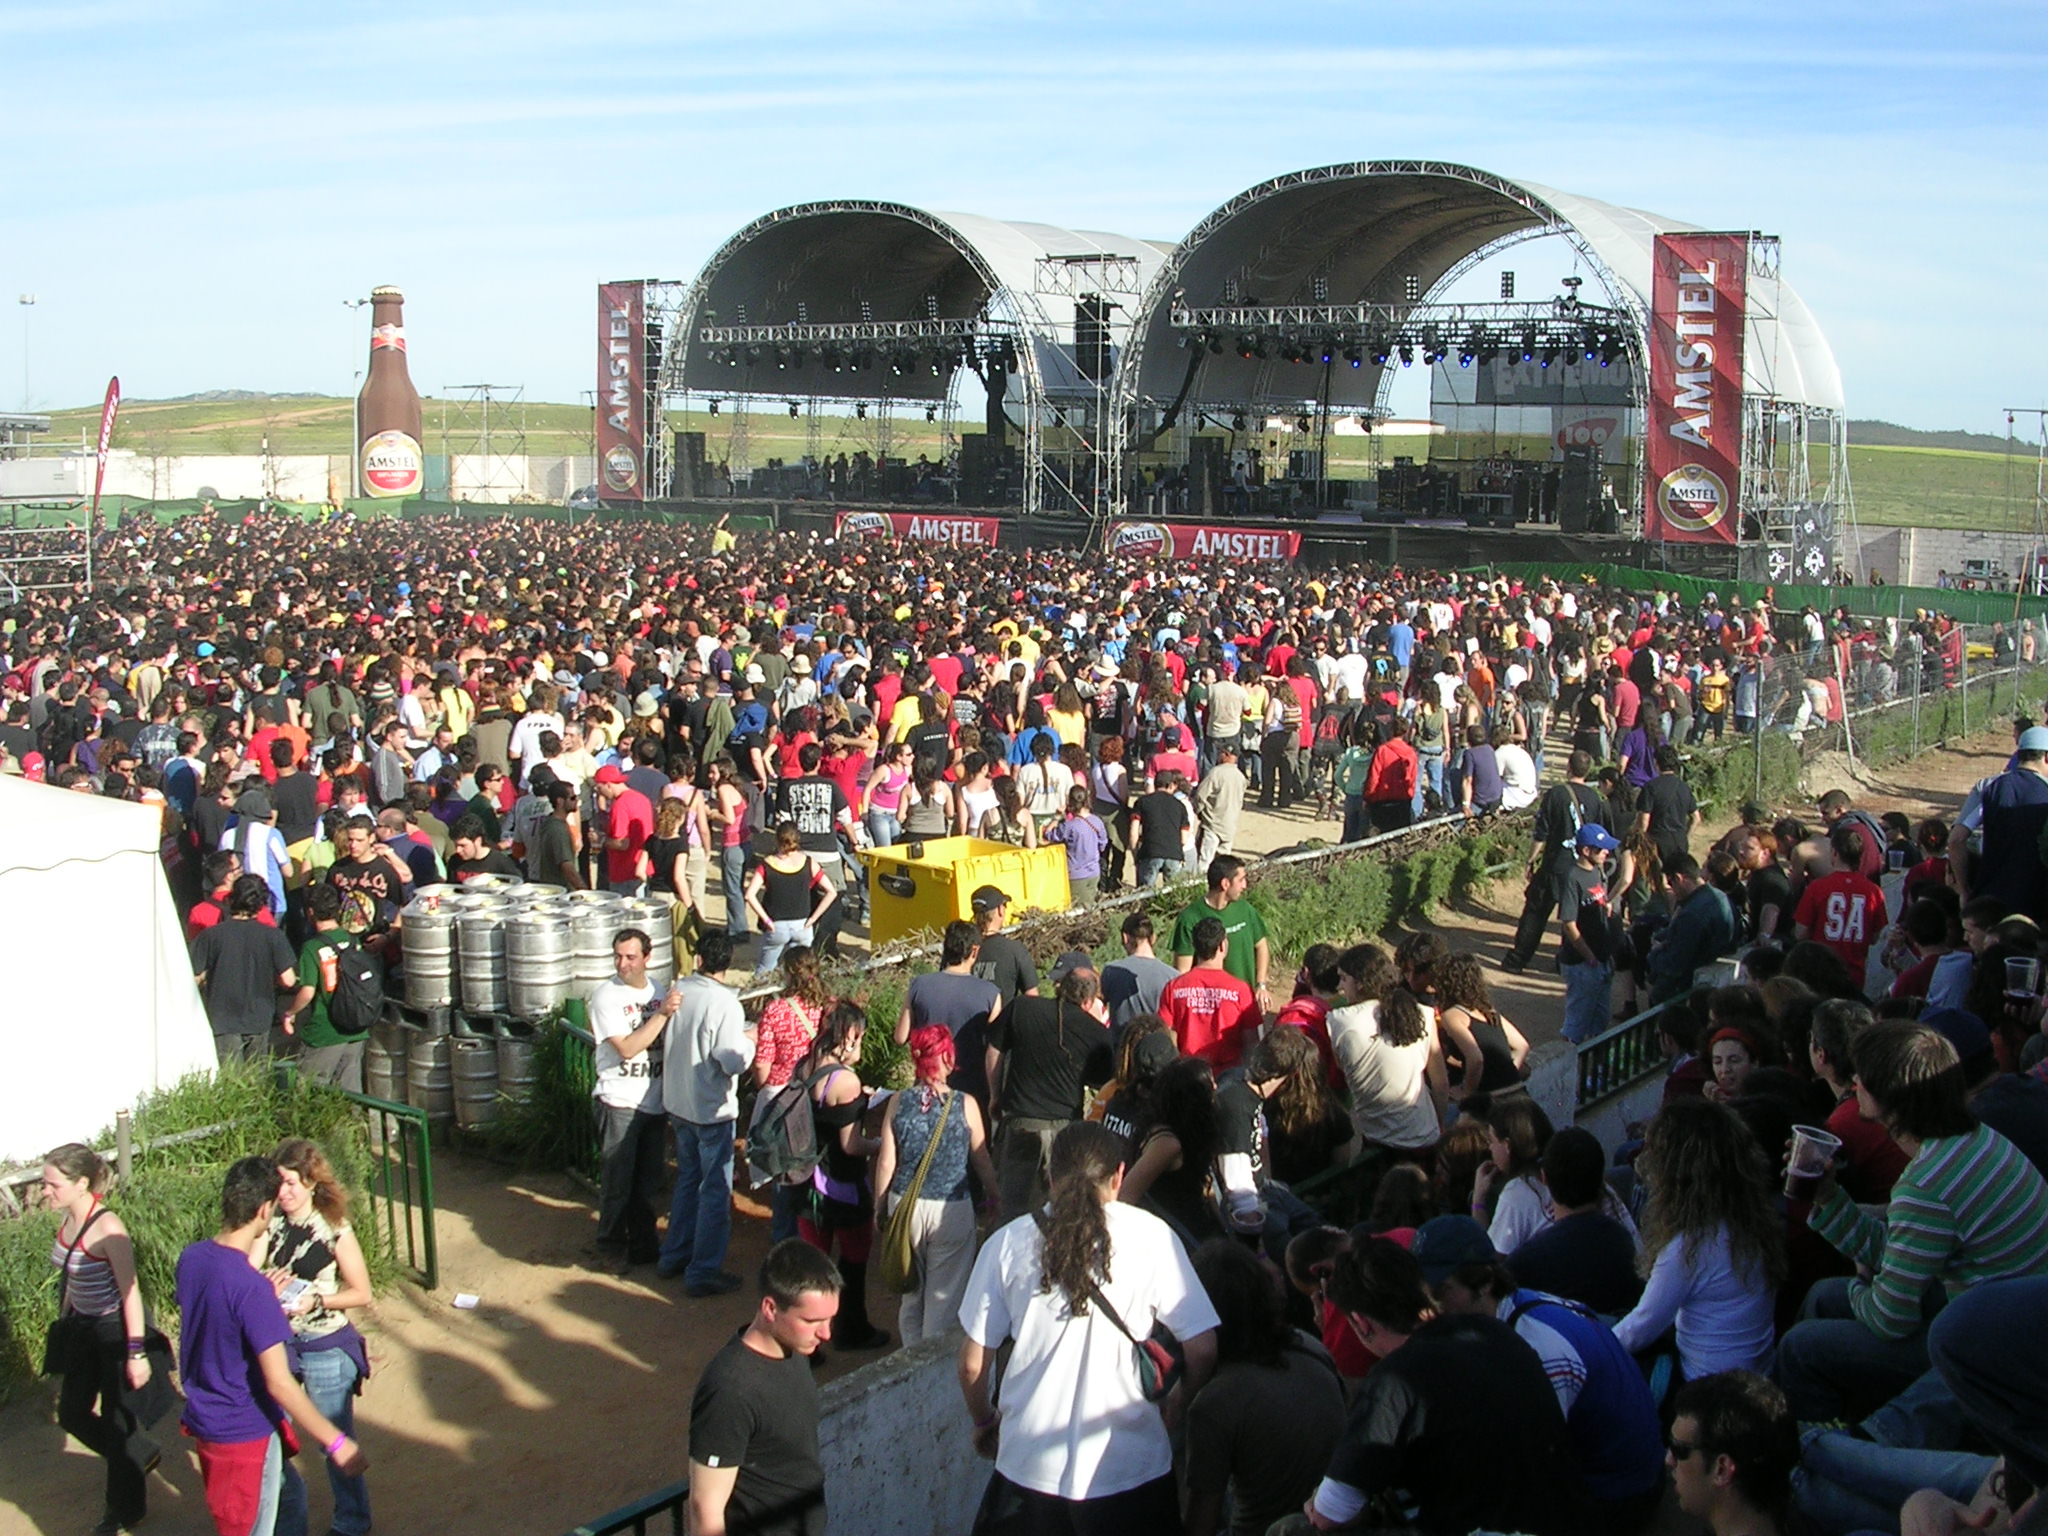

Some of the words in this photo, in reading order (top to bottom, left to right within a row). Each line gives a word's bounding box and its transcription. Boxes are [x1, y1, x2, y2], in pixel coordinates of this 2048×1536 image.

[608, 299, 631, 435] AMSTEL
[1669, 259, 1719, 449] AMSTEL
[1565, 427, 1608, 445] 100
[367, 456, 417, 469] AMSTEL
[1669, 488, 1718, 500] AMSTEL
[907, 516, 985, 543] AMSTEL
[1117, 530, 1160, 545] AMSTEL
[1191, 530, 1284, 559] AMSTEL
[1824, 891, 1867, 942] SA
